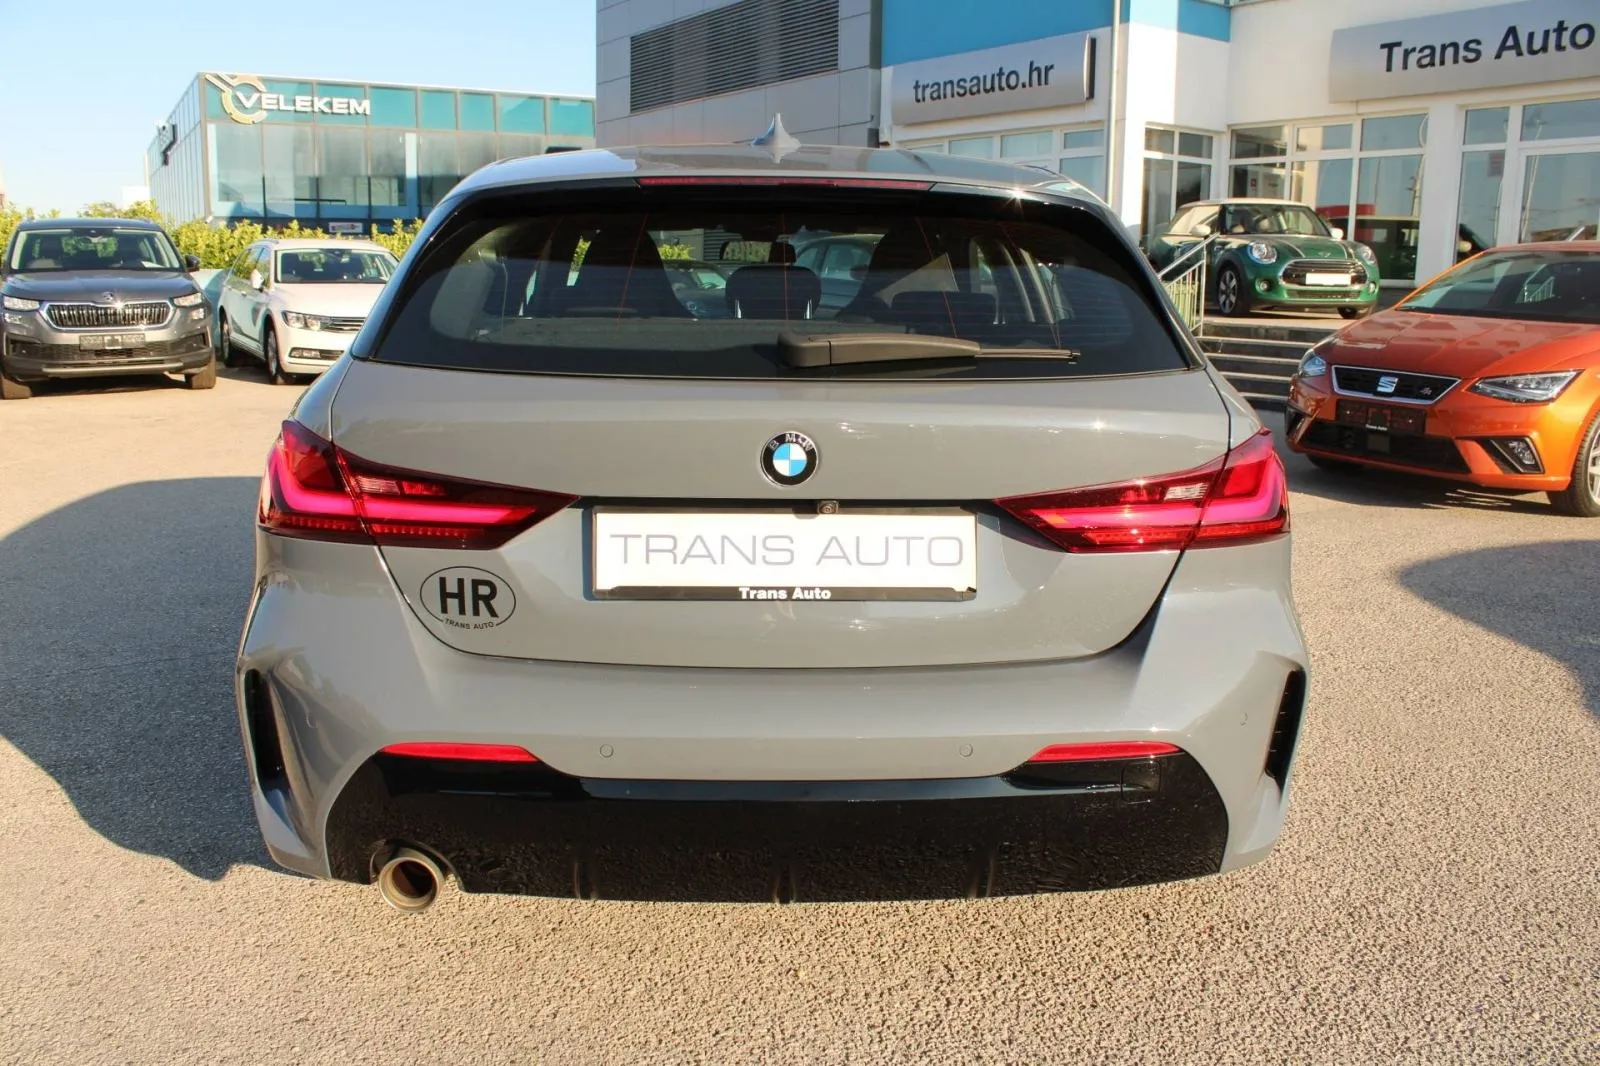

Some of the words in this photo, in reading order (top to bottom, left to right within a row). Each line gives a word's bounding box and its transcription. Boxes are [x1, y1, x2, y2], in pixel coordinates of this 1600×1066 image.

[1379, 38, 1483, 72] Trans
[1494, 20, 1596, 60] Auto
[913, 60, 1055, 103] transauto.hr
[235, 91, 371, 115] VELEKEM
[768, 432, 815, 451] BMW
[609, 534, 795, 566] TRANS
[815, 535, 964, 567] AUTO
[438, 576, 499, 618] HR
[738, 586, 788, 600] Trans
[791, 586, 832, 600] Auto
[445, 618, 471, 630] TRANS
[473, 621, 494, 630] AUTO
